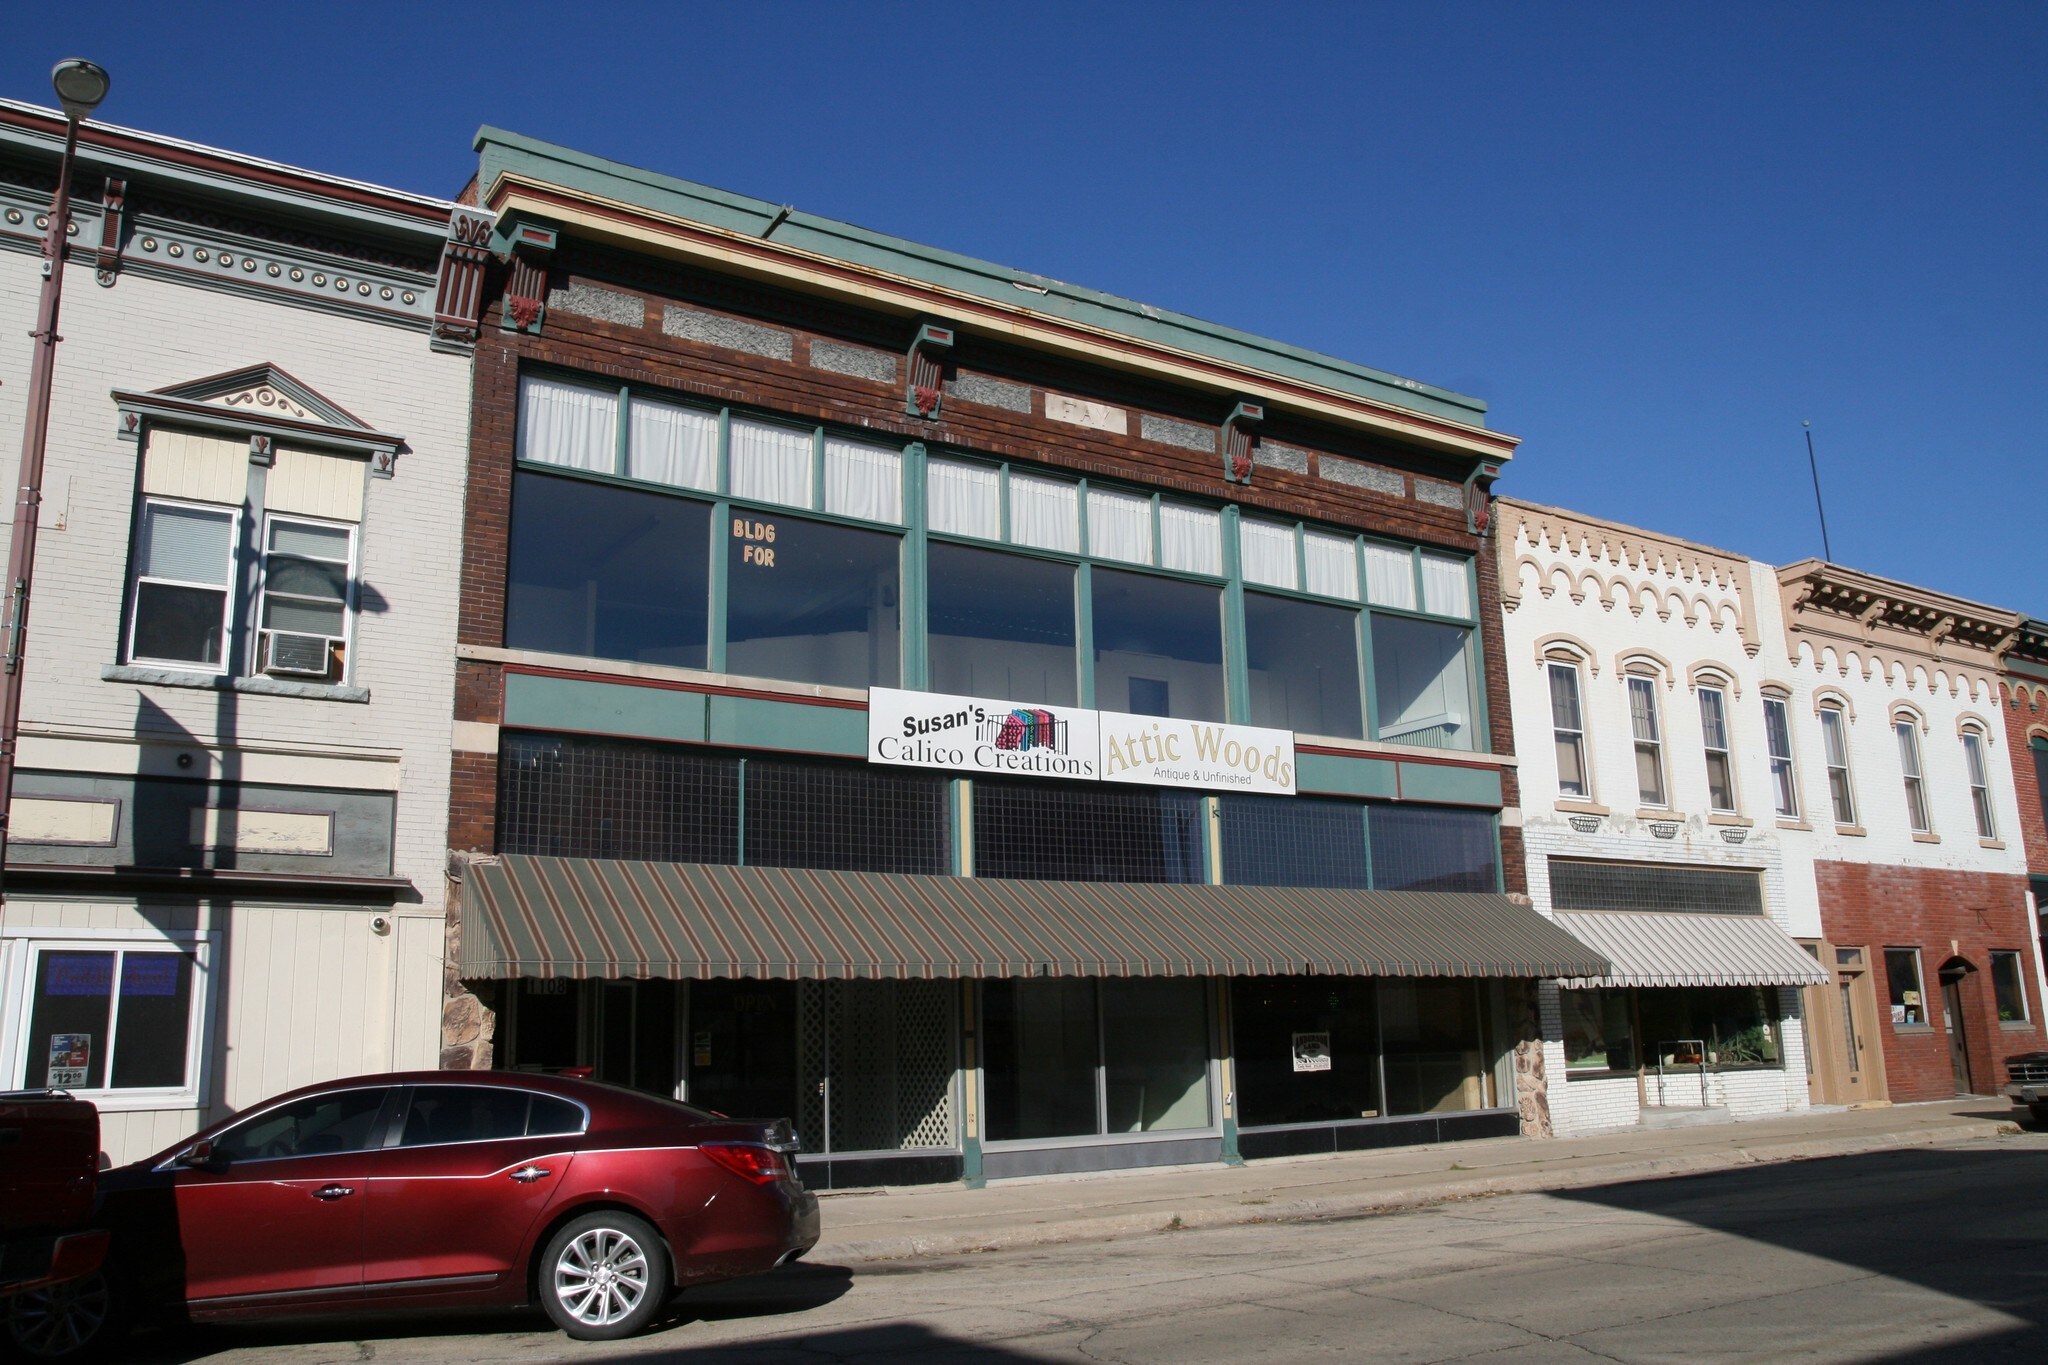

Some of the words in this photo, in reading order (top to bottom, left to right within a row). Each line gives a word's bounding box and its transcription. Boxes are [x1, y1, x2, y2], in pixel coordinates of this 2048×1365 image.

[1063, 401, 1111, 426] FAY
[733, 519, 776, 543] BLDG
[743, 545, 775, 567] FOR
[903, 704, 985, 737] Susan's
[878, 736, 964, 765] Calico
[974, 745, 1093, 775] Creations
[1107, 723, 1182, 776] Attic
[1191, 725, 1292, 788] Woods
[1154, 767, 1190, 781] Antique
[1193, 770, 1200, 781] &
[1203, 771, 1252, 784] Unfinished
[528, 978, 565, 993] 1108
[733, 994, 777, 1011] OPEN
